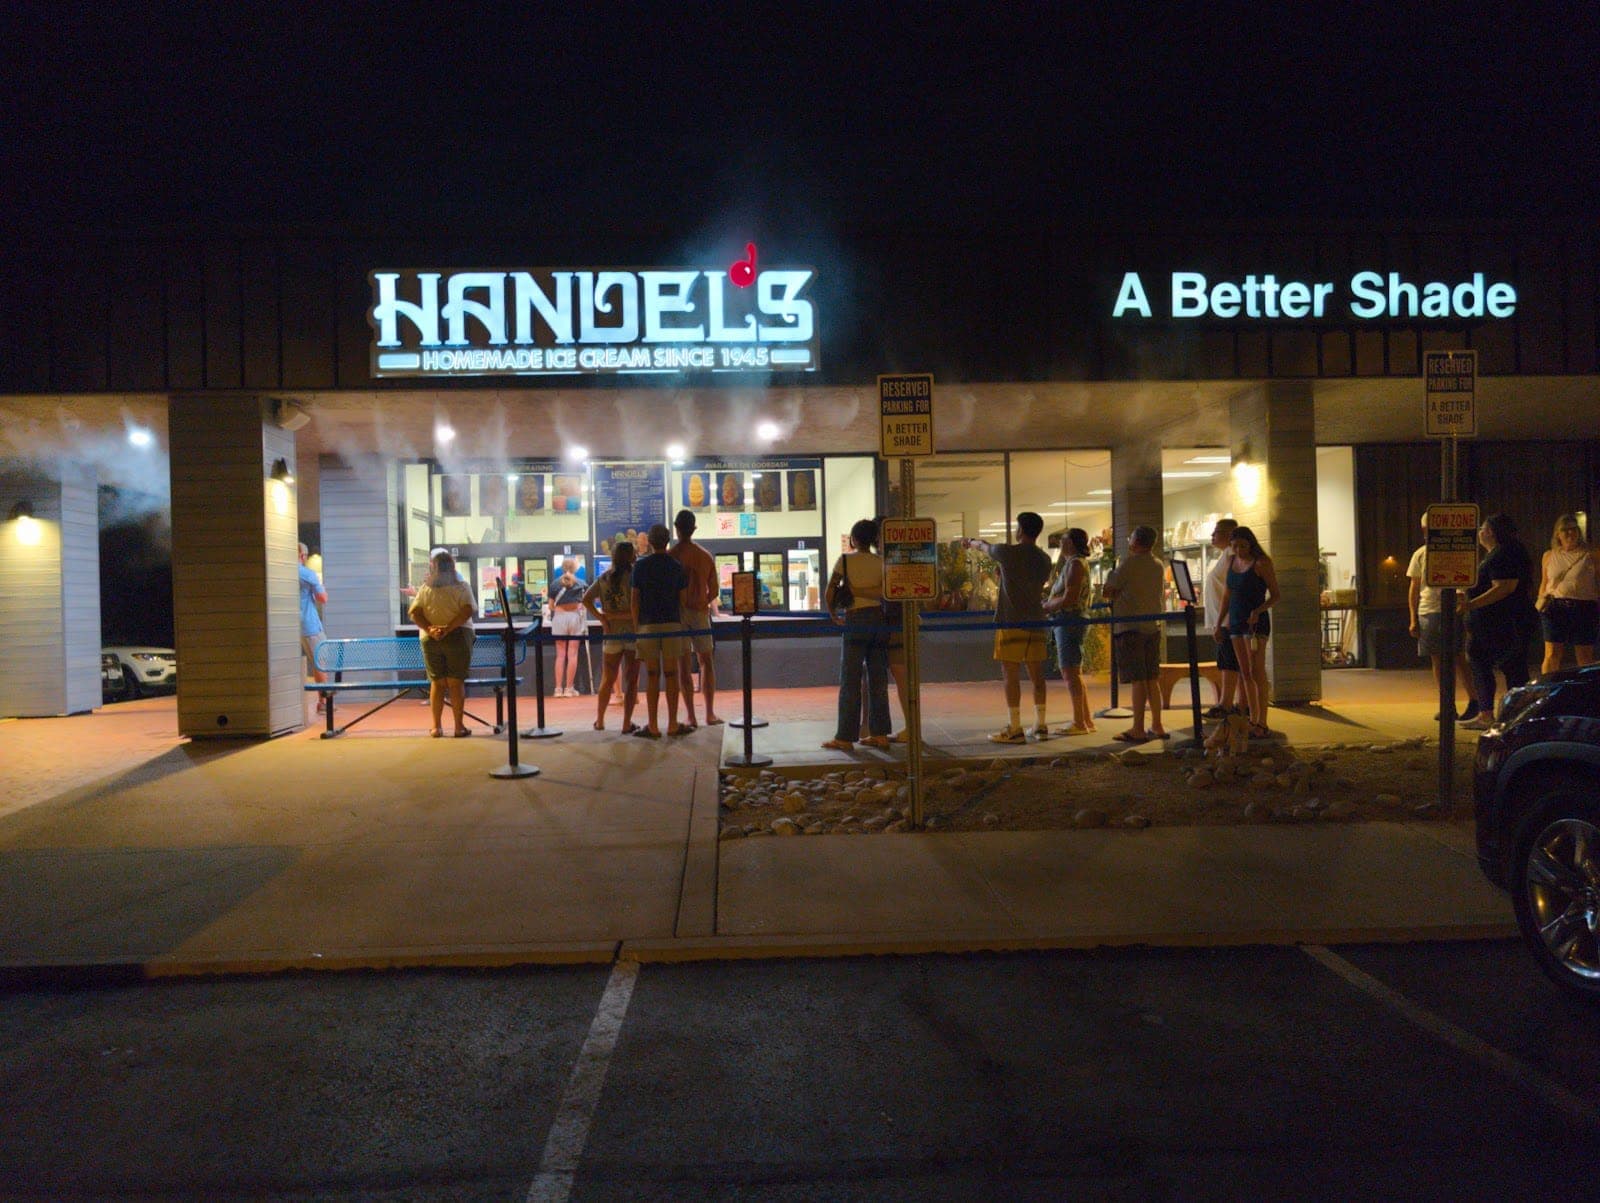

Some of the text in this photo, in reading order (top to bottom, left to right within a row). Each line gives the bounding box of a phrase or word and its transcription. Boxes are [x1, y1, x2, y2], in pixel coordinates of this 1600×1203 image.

[1112, 271, 1517, 318] A Better Shade
[423, 347, 769, 370] HOMEMADE ICE CREAM SINCE 1945
[1428, 358, 1472, 374] RESERVED
[882, 381, 929, 398] RESERVED
[882, 400, 930, 414] PARKING FOR
[1430, 401, 1470, 412] A BETTER
[1437, 413, 1465, 425] SHADE
[887, 423, 928, 434] A BETTER
[893, 434, 922, 446] SHADE
[1431, 514, 1474, 527] TOW ZONE
[886, 527, 932, 541] TOW ZONE
